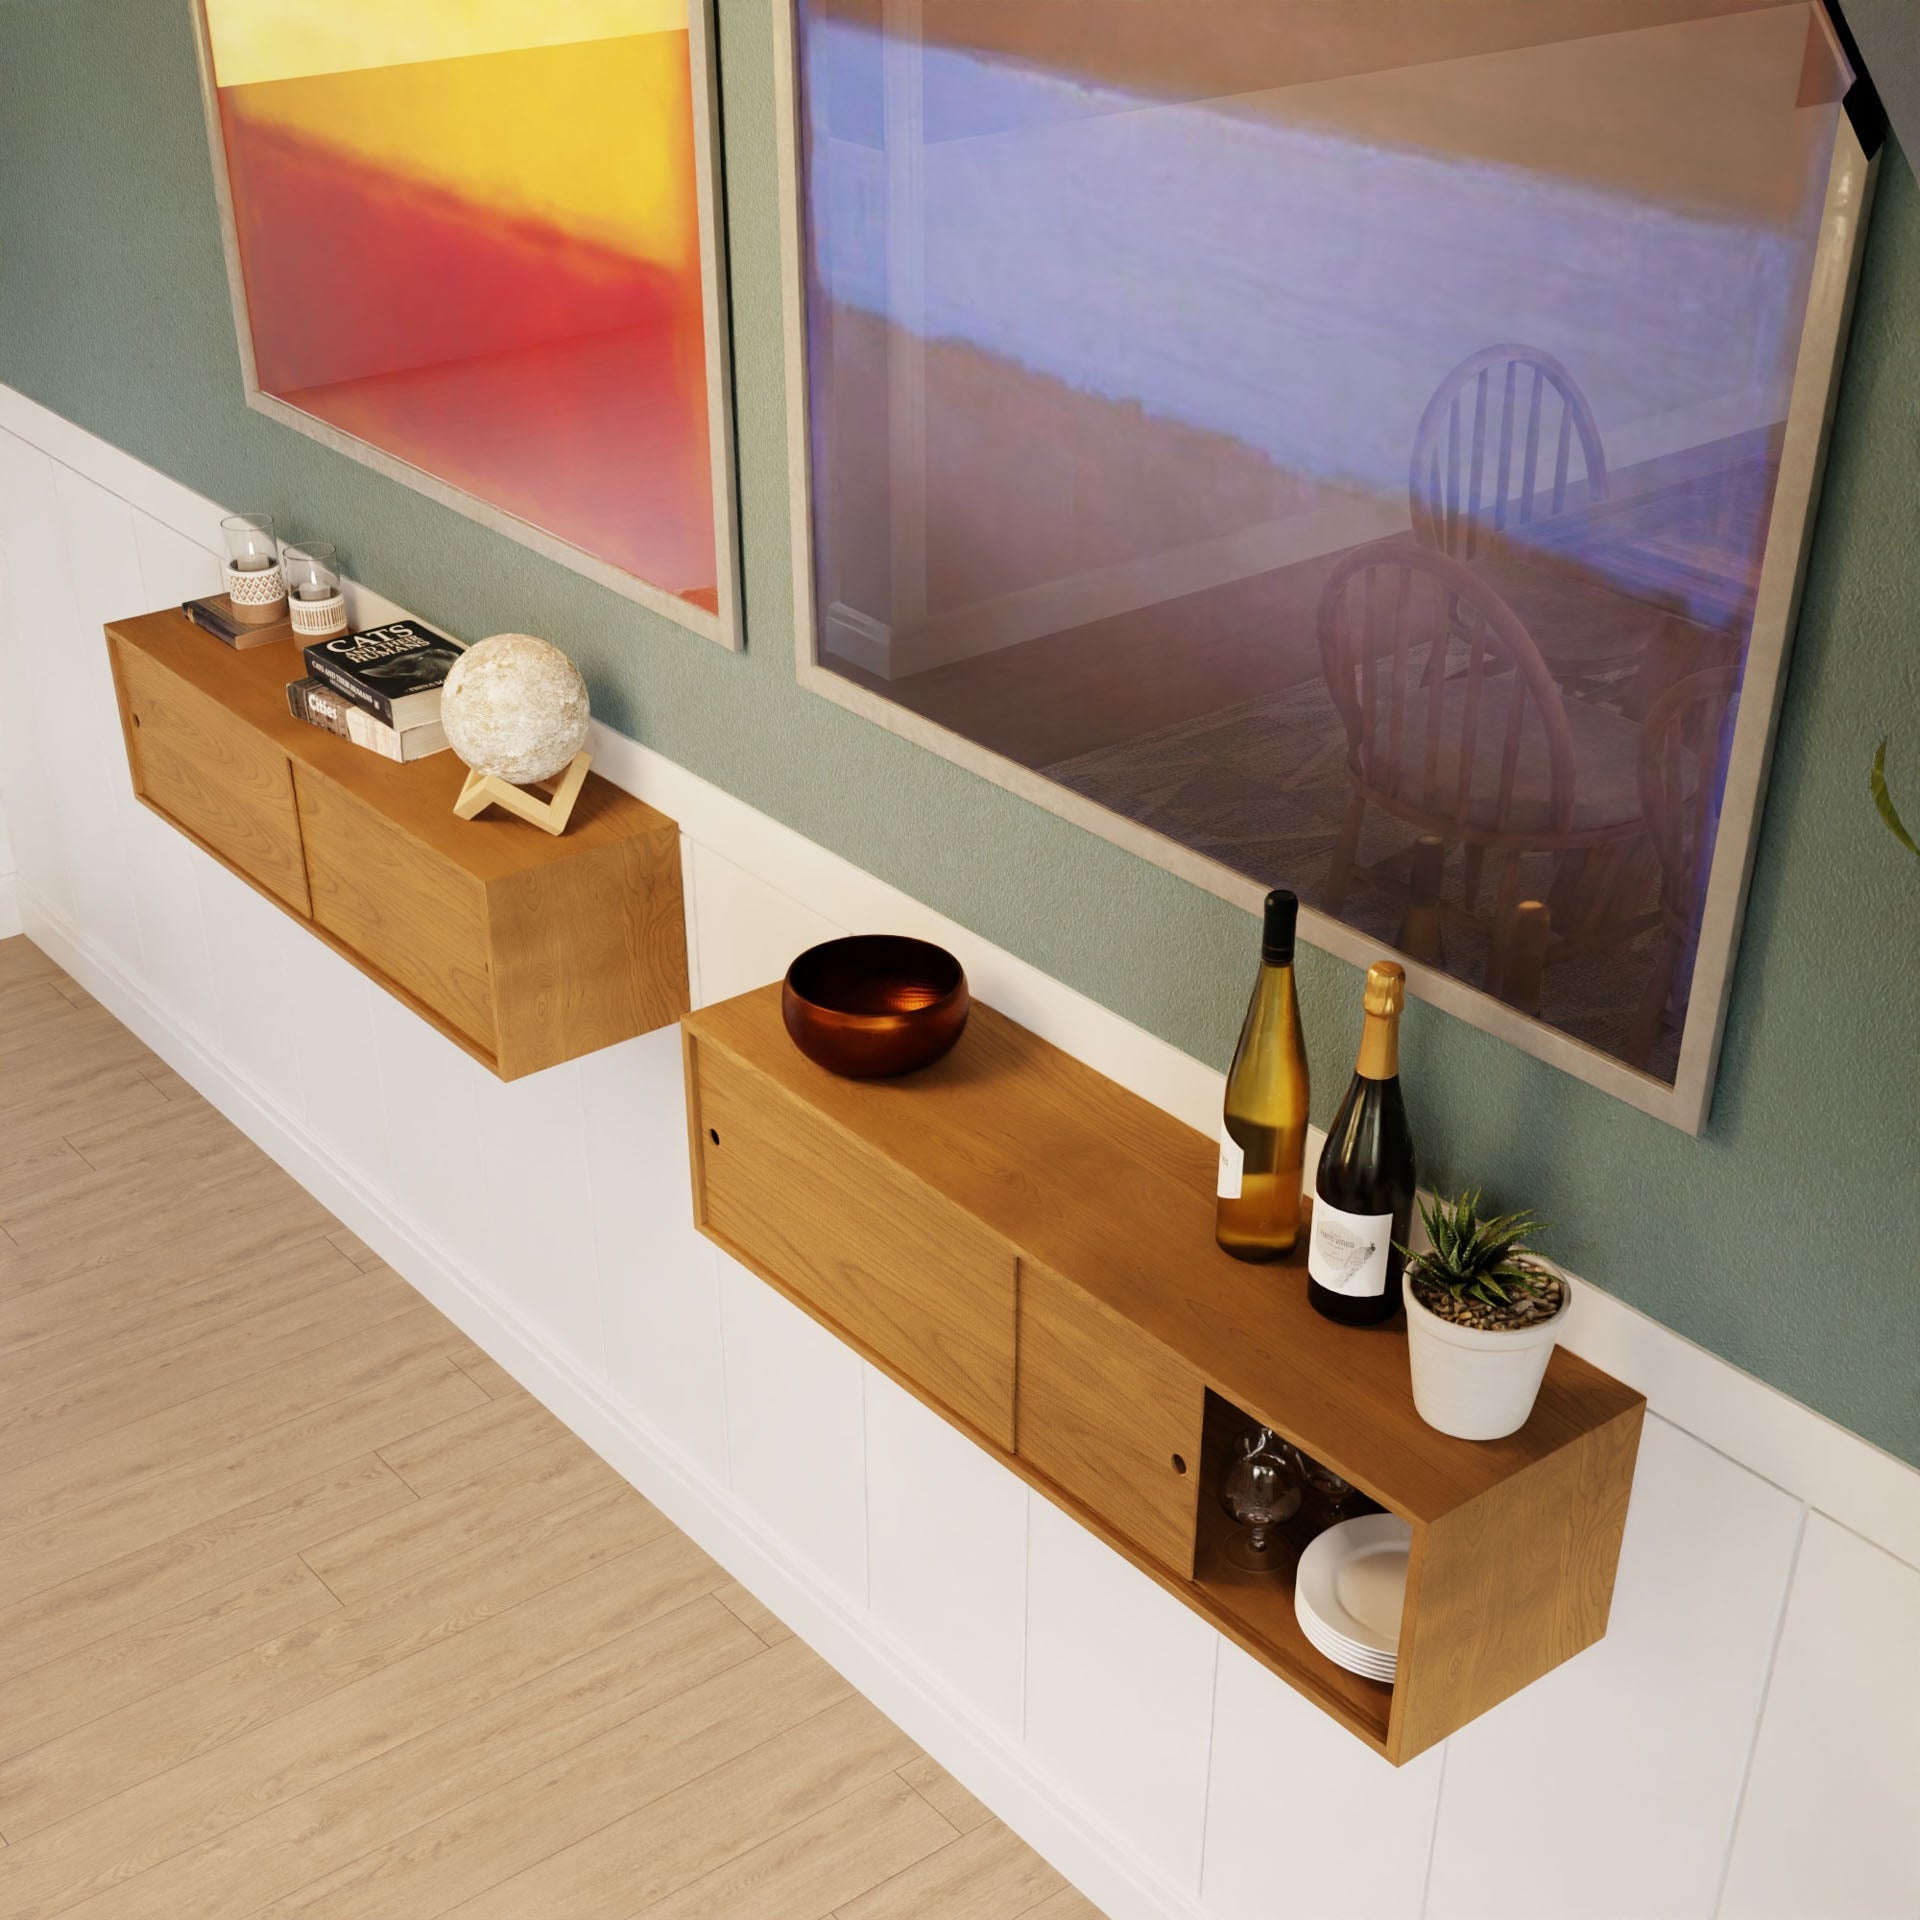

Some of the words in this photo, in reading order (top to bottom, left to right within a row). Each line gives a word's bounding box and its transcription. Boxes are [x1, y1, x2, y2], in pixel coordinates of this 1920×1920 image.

[327, 625, 413, 653] CATS
[345, 645, 376, 659] AND
[376, 635, 420, 649] THEIR
[346, 640, 430, 663] HUMANS
[308, 692, 338, 720] Cities
